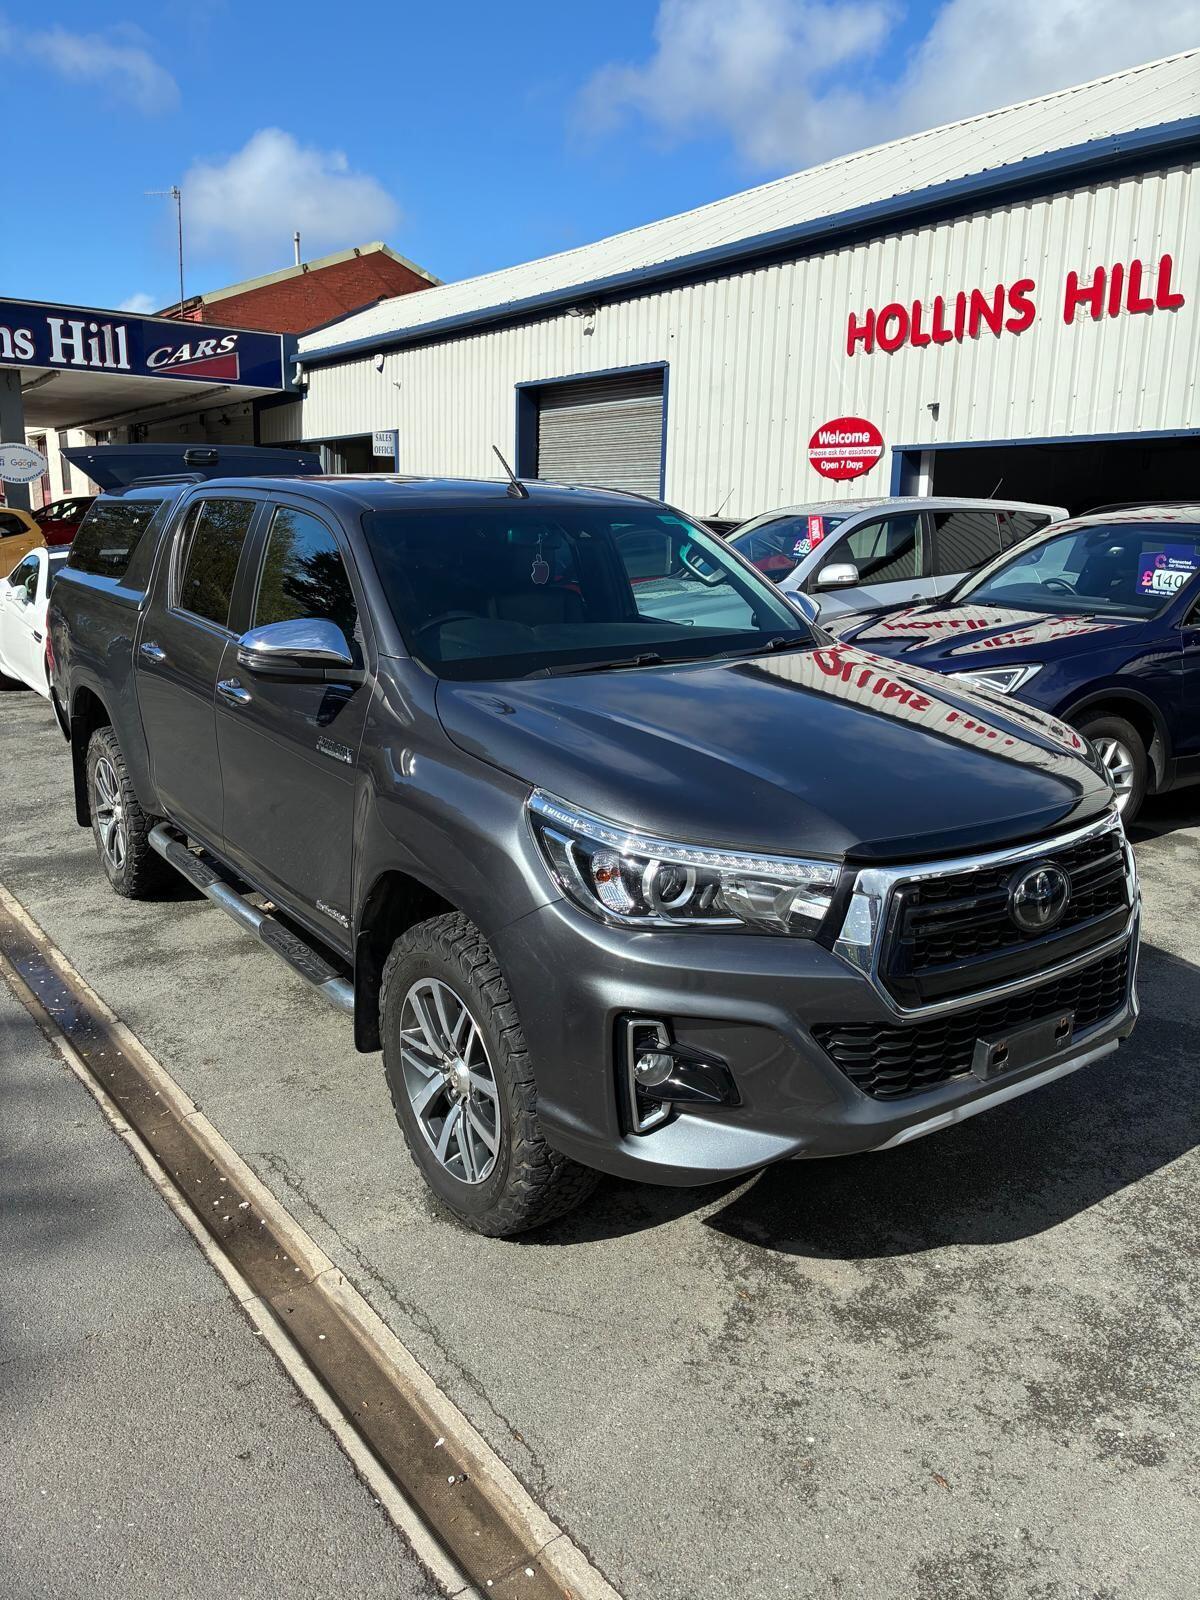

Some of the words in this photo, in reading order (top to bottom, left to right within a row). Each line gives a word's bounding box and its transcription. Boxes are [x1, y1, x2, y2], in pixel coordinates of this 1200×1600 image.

[846, 278, 1036, 358] HOLLINS
[1063, 253, 1186, 326] HILL
[46, 317, 131, 369] Hill
[146, 334, 238, 368] CARS
[375, 432, 392, 442] SALES
[818, 430, 871, 445] Welcome
[374, 445, 394, 454] OFFICE
[809, 449, 827, 457] Please
[848, 447, 877, 456] assistance
[10, 459, 37, 468] Google
[820, 460, 839, 471] Open
[840, 460, 846, 469] 7
[846, 460, 864, 470] Days
